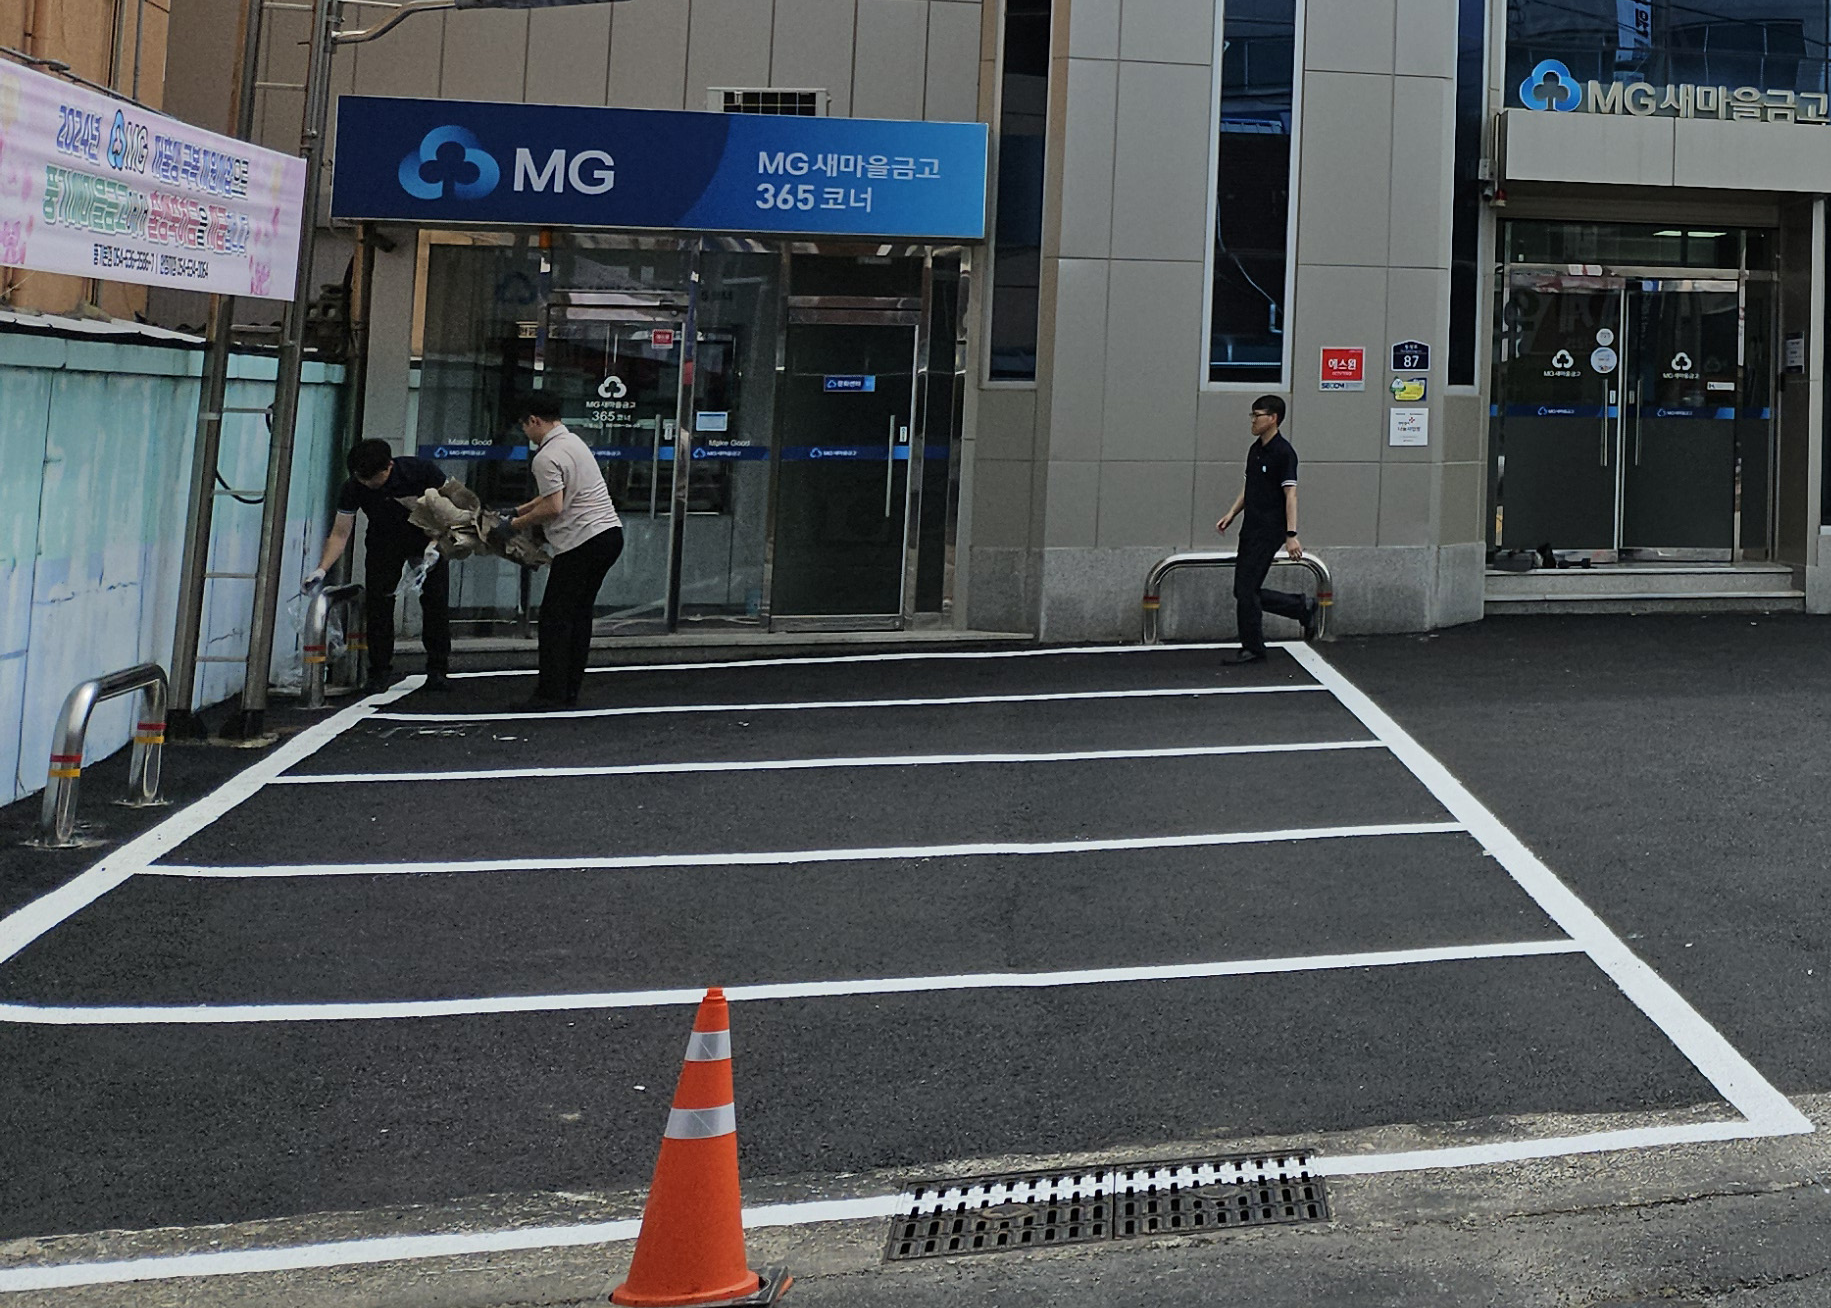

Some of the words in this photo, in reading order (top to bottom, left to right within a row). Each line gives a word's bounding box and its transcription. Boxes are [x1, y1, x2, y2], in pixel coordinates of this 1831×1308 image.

[1587, 80, 1831, 126] MG새마을금고
[56, 105, 102, 166] 2024년
[124, 122, 148, 174] MG
[513, 149, 616, 195] MG
[758, 151, 941, 181] MG새마을금고
[1327, 358, 1358, 371] 에스원
[1403, 355, 1420, 368] 87
